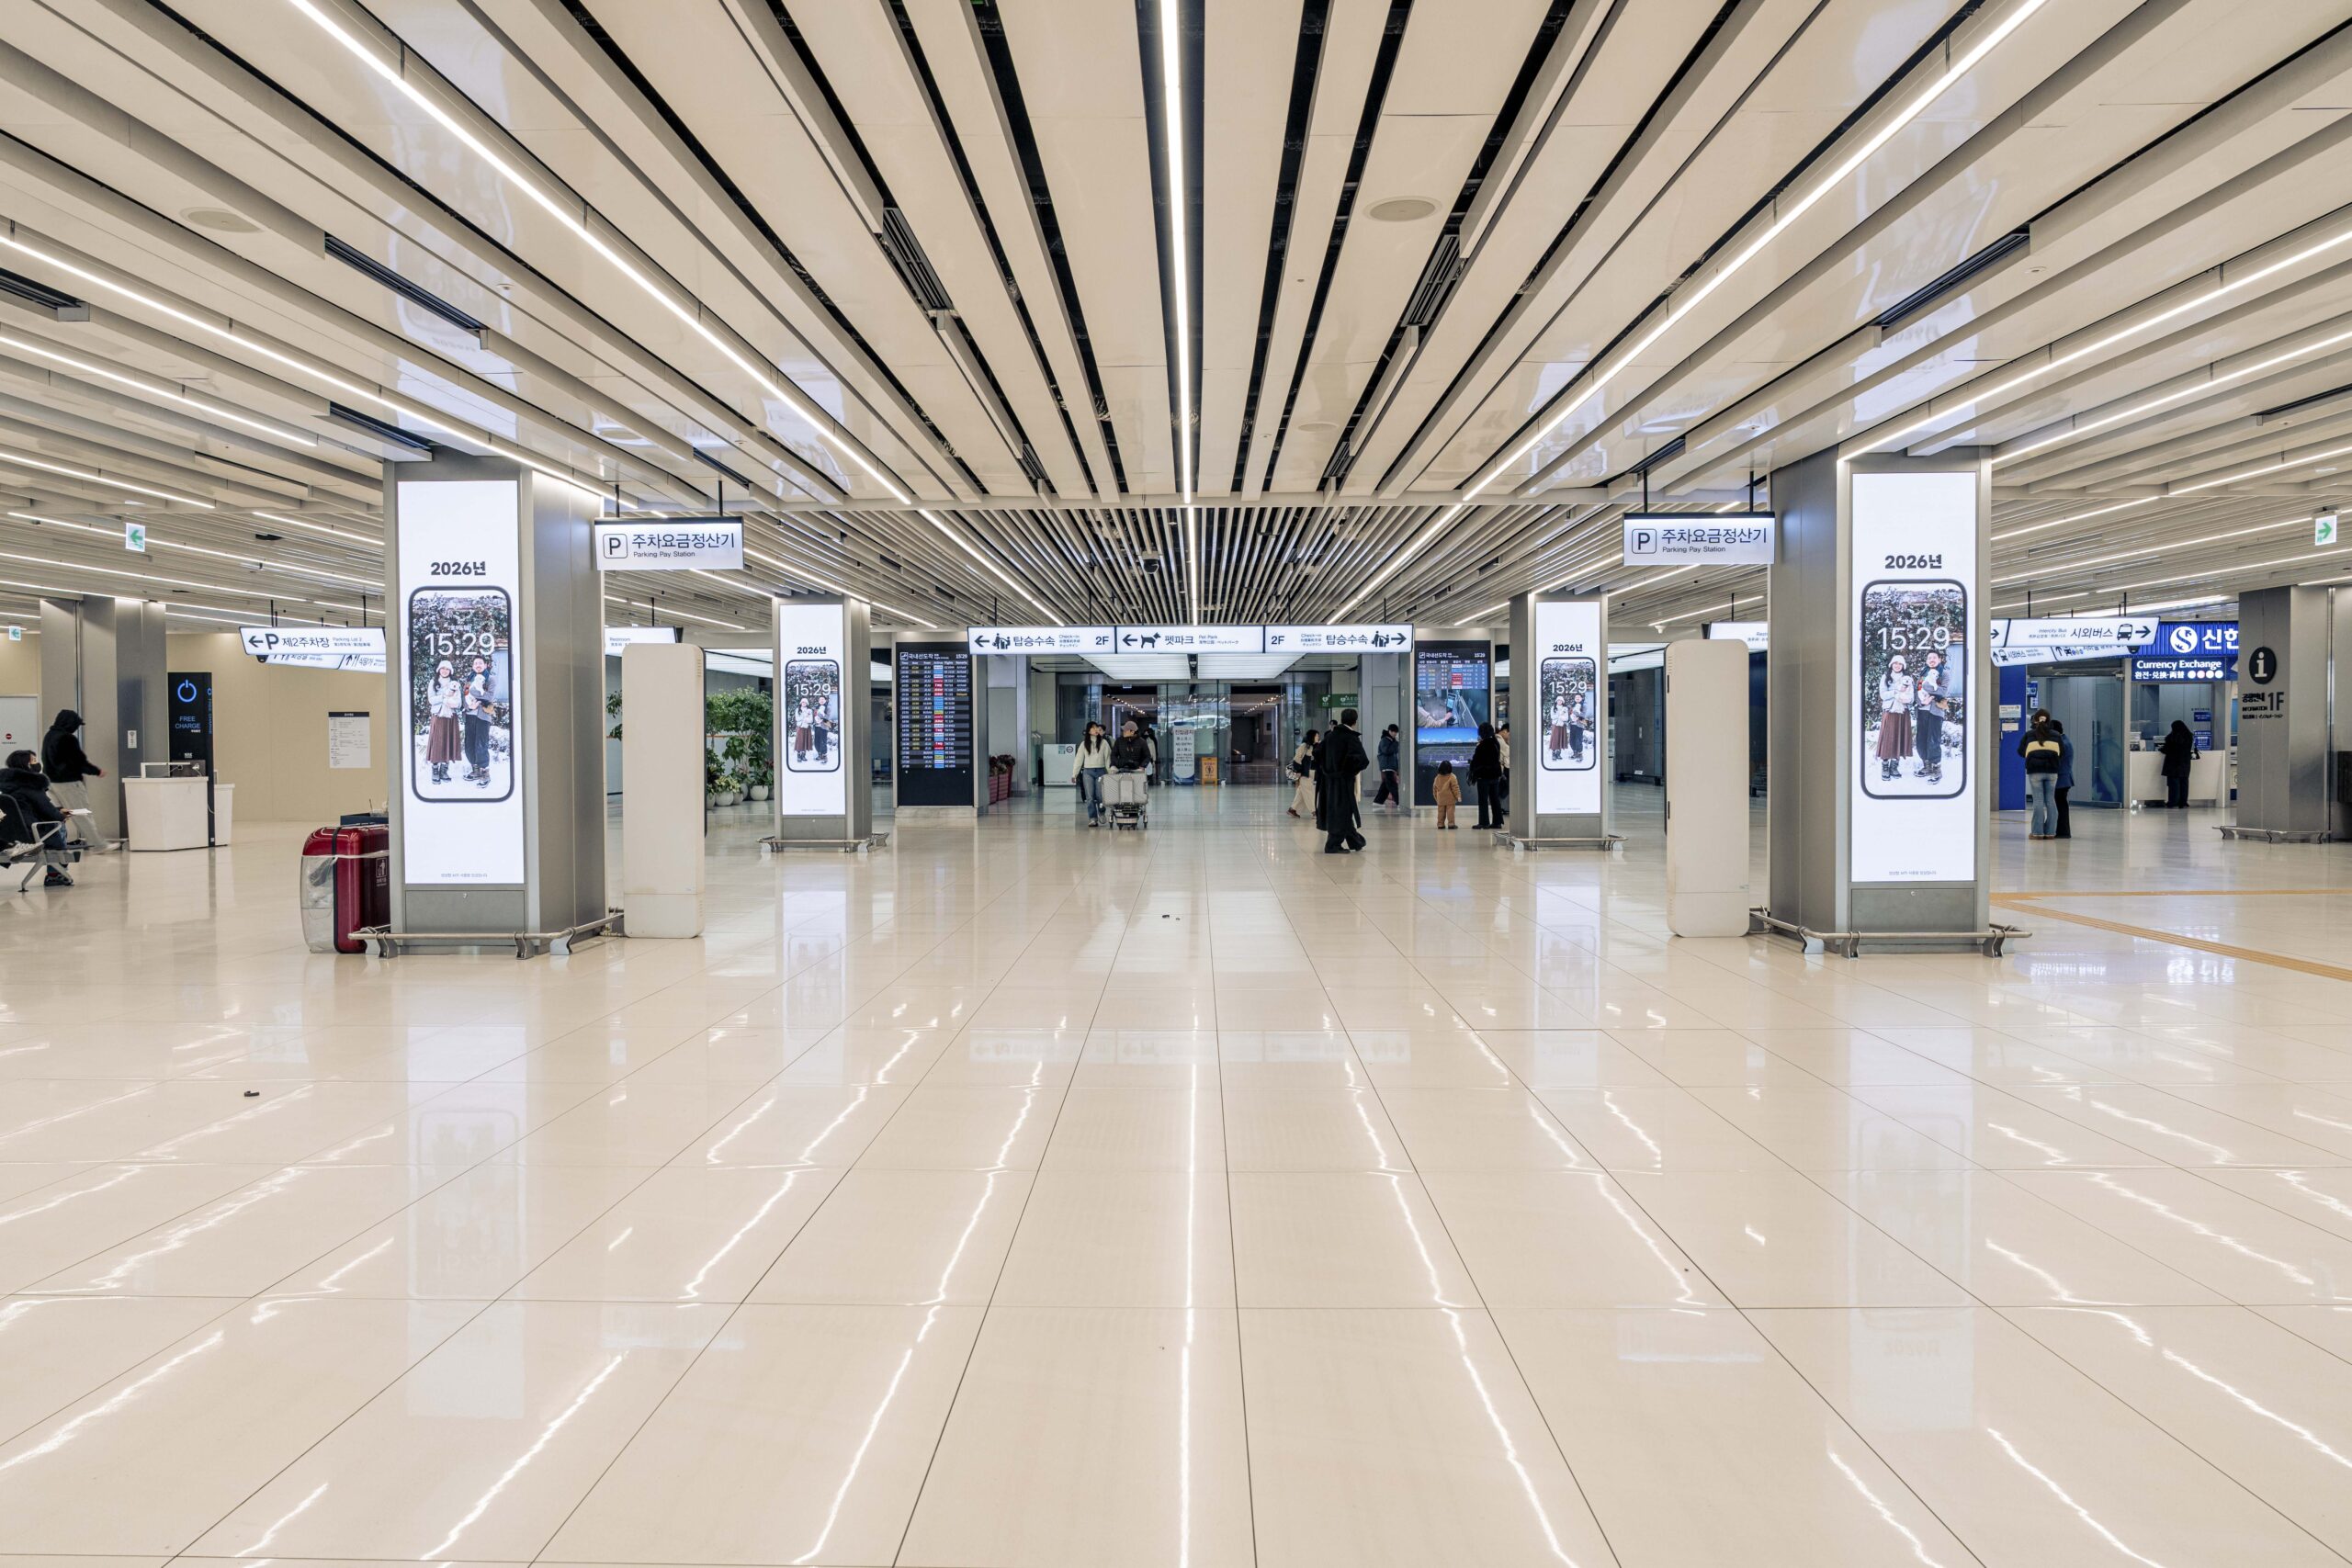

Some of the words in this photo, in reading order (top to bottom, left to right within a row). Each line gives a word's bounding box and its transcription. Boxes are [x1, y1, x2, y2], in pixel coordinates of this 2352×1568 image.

[632, 533, 734, 549] 주차요금정산기
[1638, 533, 1650, 550] P
[1661, 528, 1767, 544] 주차요금정산기
[609, 537, 621, 555] P
[431, 561, 486, 575] 2026년
[1884, 554, 1942, 569] 2026년
[1877, 626, 1950, 649] 15:29
[2070, 627, 2112, 638] 시외버스
[282, 637, 330, 648] 제2주차장
[424, 632, 495, 655] 15:29
[1013, 636, 1056, 647] 탑승수속
[1095, 636, 1109, 645] 2F
[1165, 635, 1194, 645] 펫파크
[1272, 636, 1284, 645] 2F
[1326, 634, 1368, 645] 탑승수속
[2136, 660, 2177, 670] Currency
[2179, 660, 2222, 670] Exchange
[793, 683, 831, 695] 15:29
[1549, 681, 1587, 694] 15:29
[2267, 692, 2284, 711] 1F
